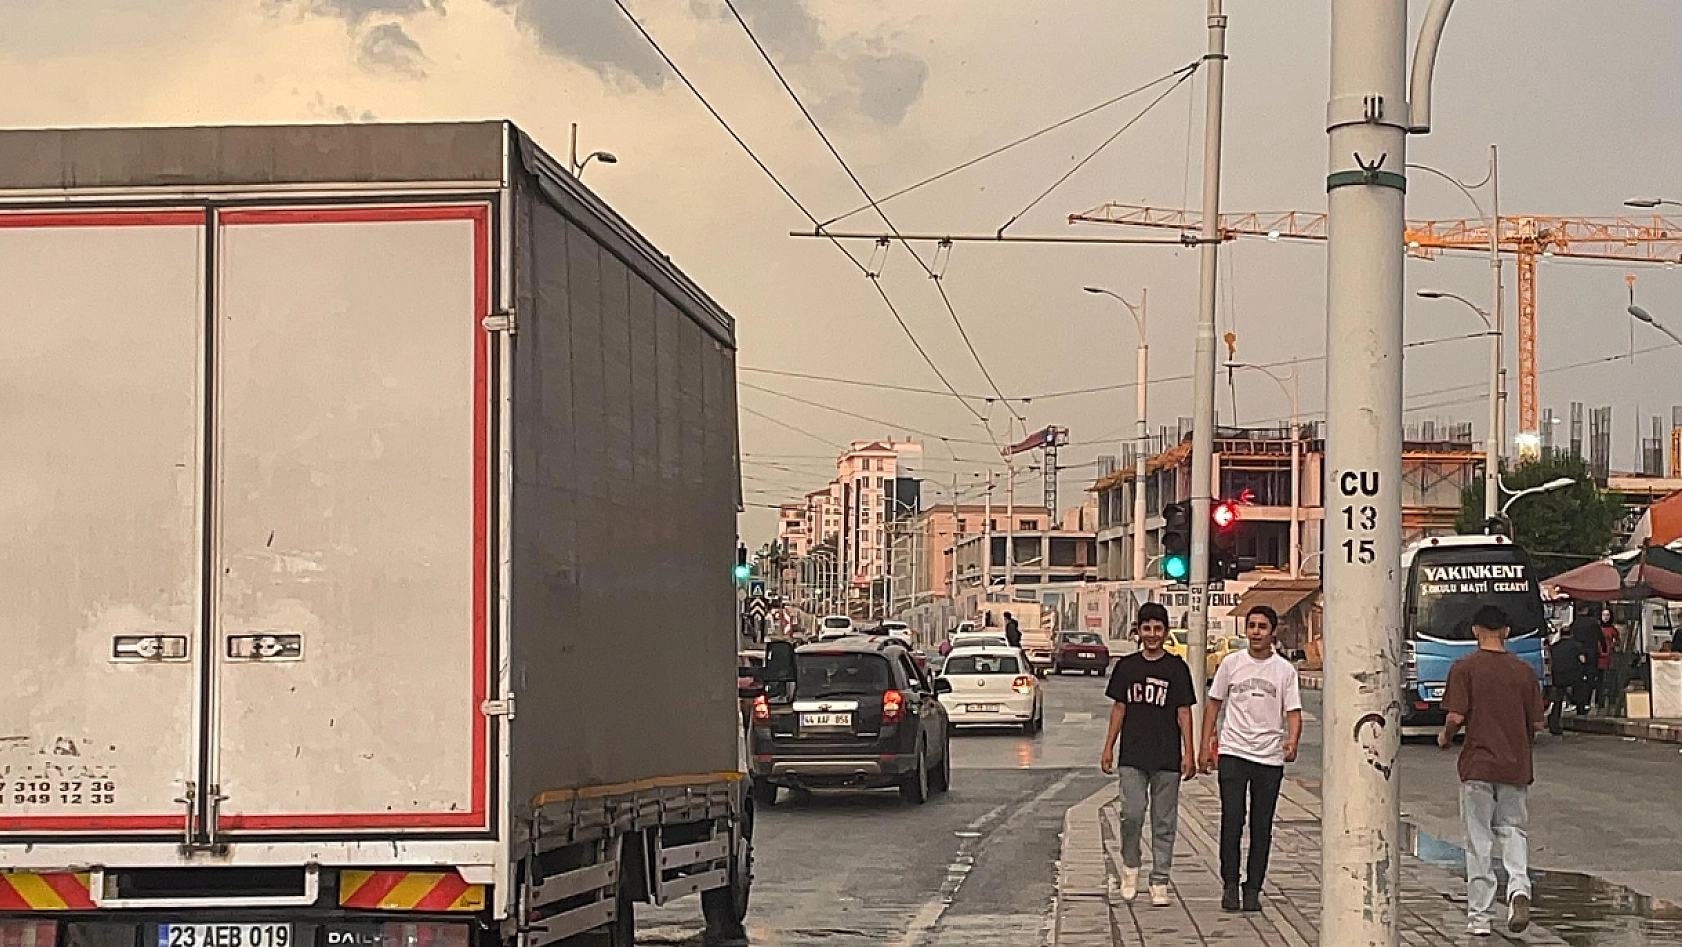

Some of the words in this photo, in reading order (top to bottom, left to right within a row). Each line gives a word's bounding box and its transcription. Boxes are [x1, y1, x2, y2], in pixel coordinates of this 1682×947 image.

[1340, 471, 1379, 496] CU
[1342, 505, 1377, 530] 13
[1342, 539, 1376, 564] 15
[1424, 565, 1525, 581] YAKINKENT
[1191, 587, 1202, 595] CU
[1127, 682, 1168, 707] ICON
[14, 782, 51, 792] 310
[60, 782, 82, 792] 37
[91, 782, 116, 792] 36
[14, 794, 51, 804] 949
[60, 794, 82, 804] 12
[91, 794, 115, 804] 35
[170, 926, 195, 947] 23
[203, 926, 241, 947] AEB
[249, 926, 288, 947] 019
